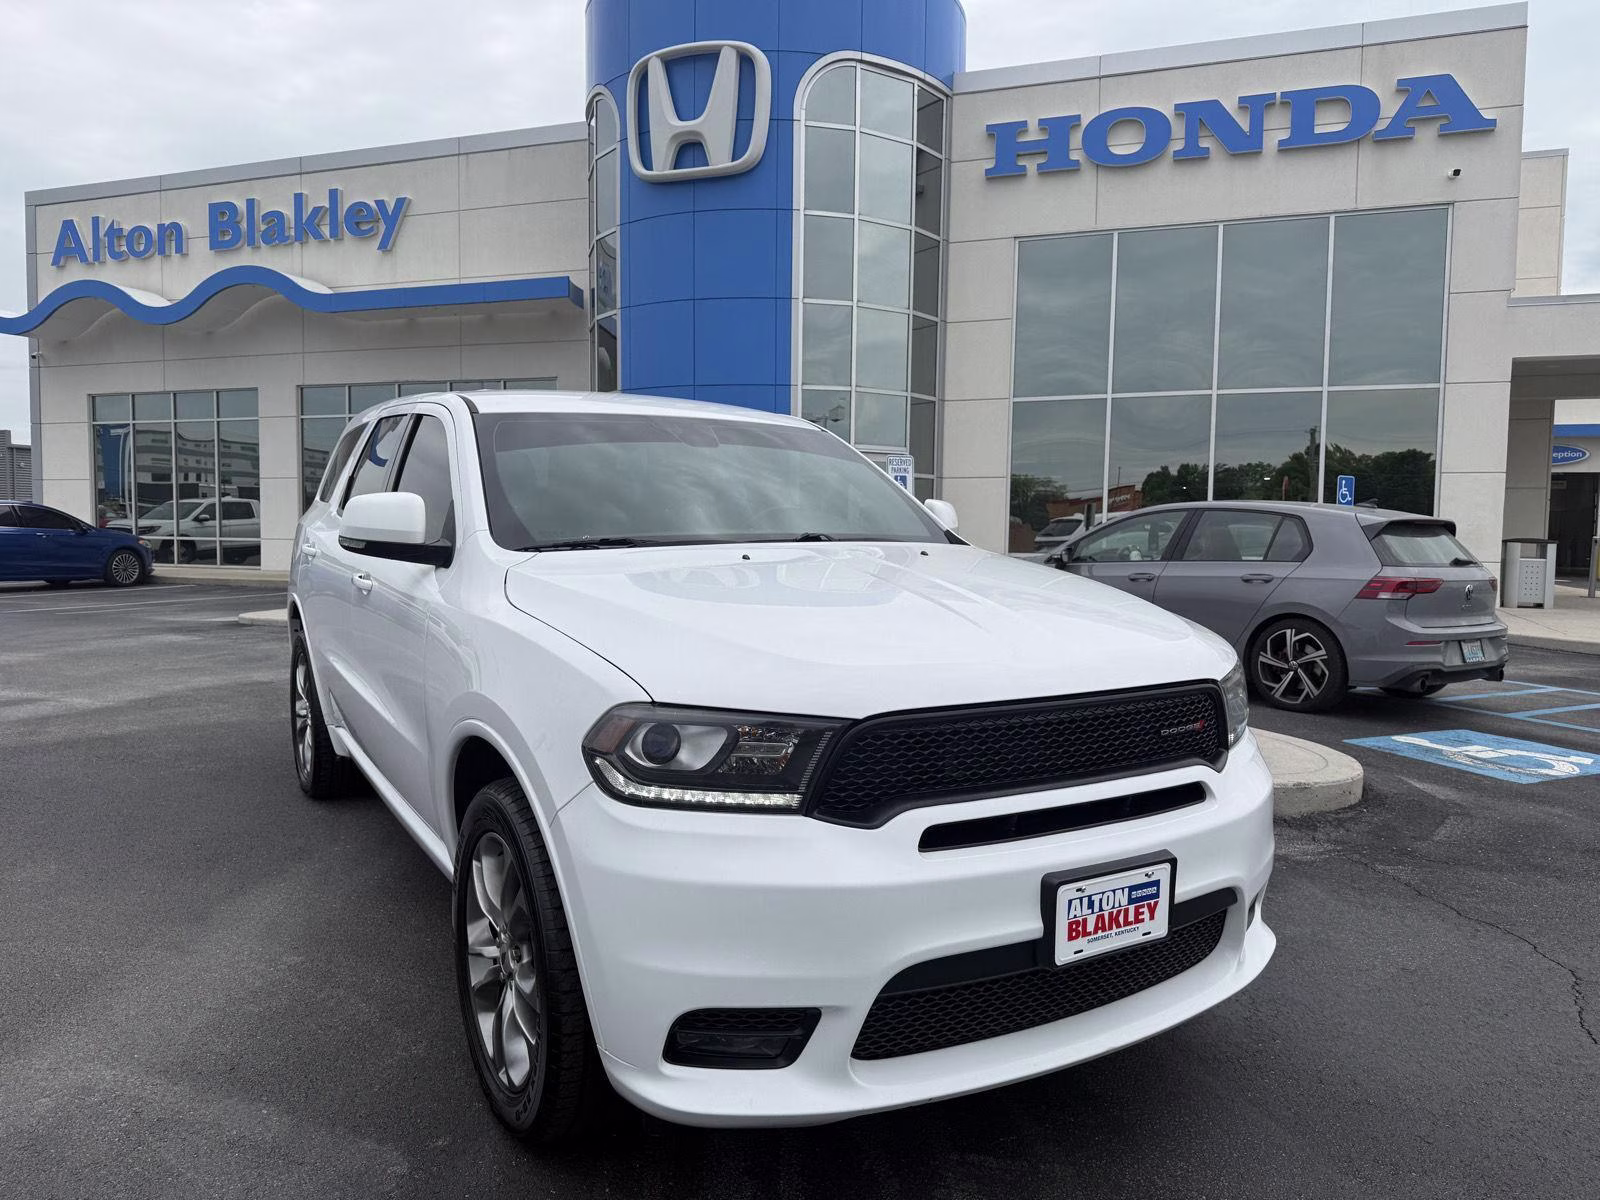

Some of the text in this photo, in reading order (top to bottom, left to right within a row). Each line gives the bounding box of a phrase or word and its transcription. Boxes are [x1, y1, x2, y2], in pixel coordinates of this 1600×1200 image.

[985, 73, 1497, 179] HONDA
[51, 187, 411, 268] Alton Blakley
[888, 458, 912, 467] RESERVED
[1552, 450, 1583, 459] eption
[890, 466, 910, 474] PARKING
[1068, 887, 1129, 919] ALTON
[1067, 900, 1160, 943] BLAKLEY
[1086, 926, 1140, 944] SOMERSET, KENTUCKY
